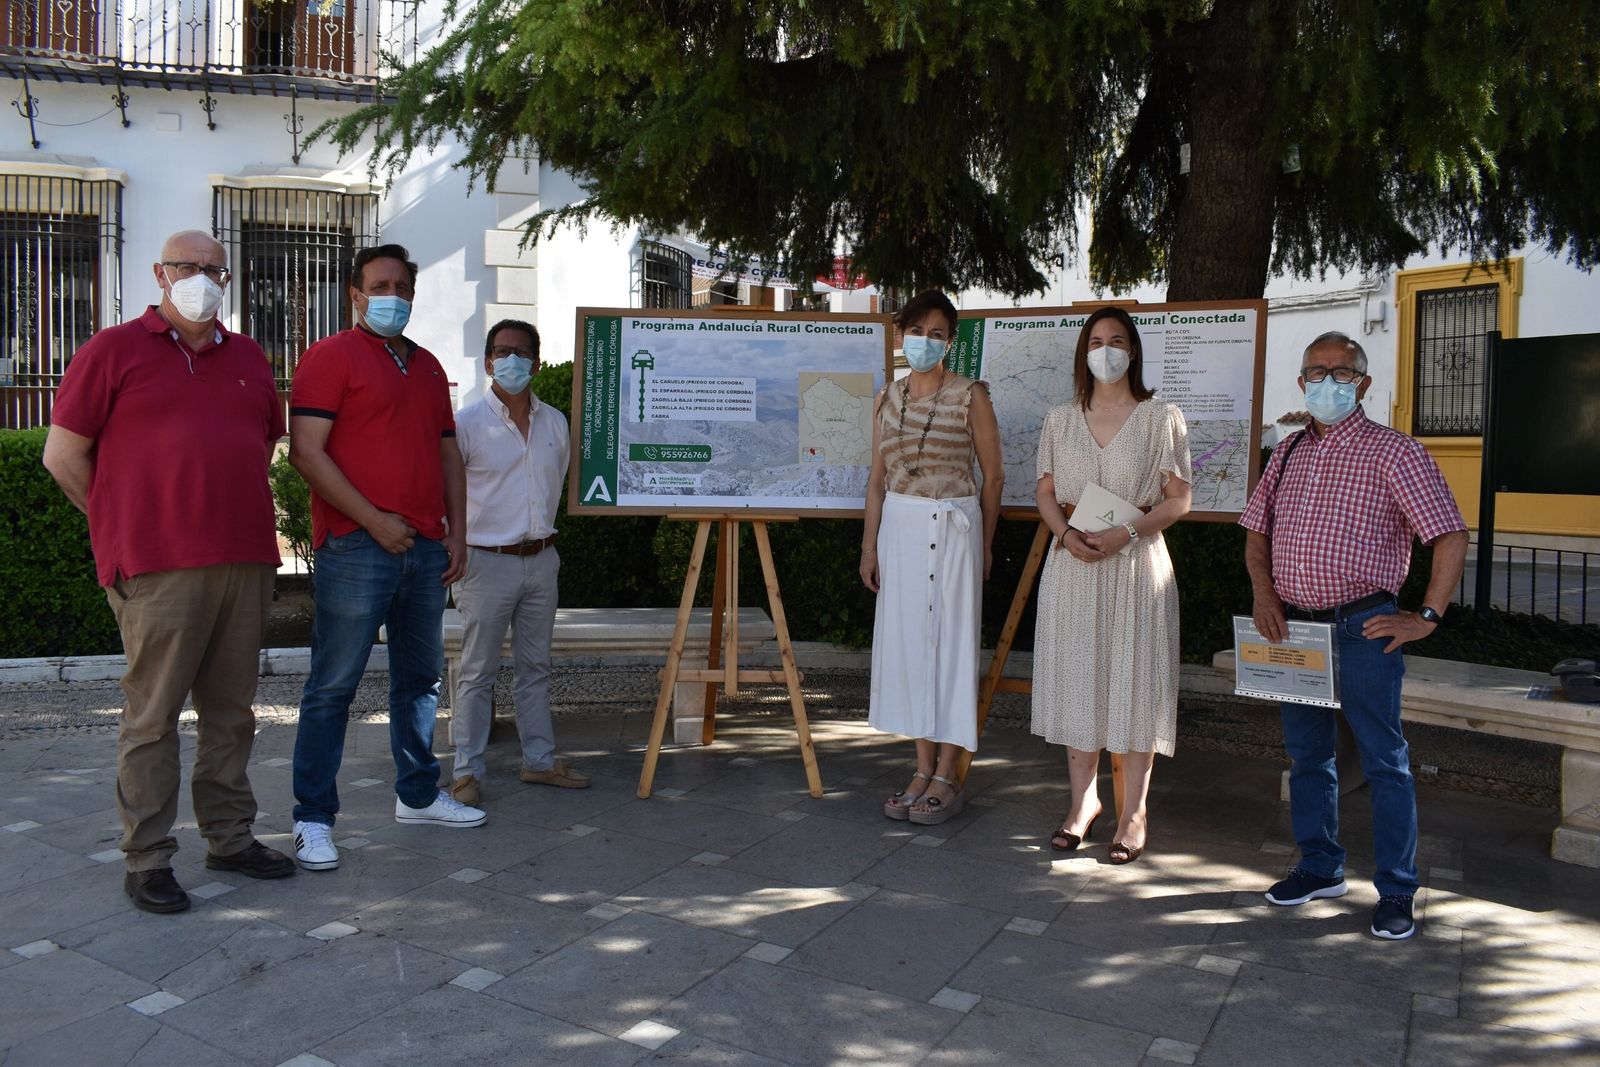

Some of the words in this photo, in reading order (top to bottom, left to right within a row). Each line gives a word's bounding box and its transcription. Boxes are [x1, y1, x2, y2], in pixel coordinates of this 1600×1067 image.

[608, 320, 617, 354] CÓRDOBA
[632, 320, 694, 332] Programa
[699, 320, 763, 332] Andalucía
[768, 323, 800, 332] Rural
[805, 324, 873, 334] Conectada
[995, 320, 1055, 331] Programa
[1060, 318, 1085, 327] And
[1131, 316, 1165, 325] Rural
[1170, 313, 1245, 324] Conectada
[586, 321, 595, 380] INFRAESTRUCTURAS
[972, 321, 980, 355] CÓRDOBA
[596, 340, 604, 374] TERRITORIO
[609, 356, 616, 366] DE
[971, 357, 977, 366] DE
[585, 381, 593, 411] FOMENTO,
[608, 367, 616, 412] TERRITORIAL
[585, 412, 592, 420] DE
[584, 421, 592, 459] CONSEJERÍA
[661, 451, 708, 459] 955926766
